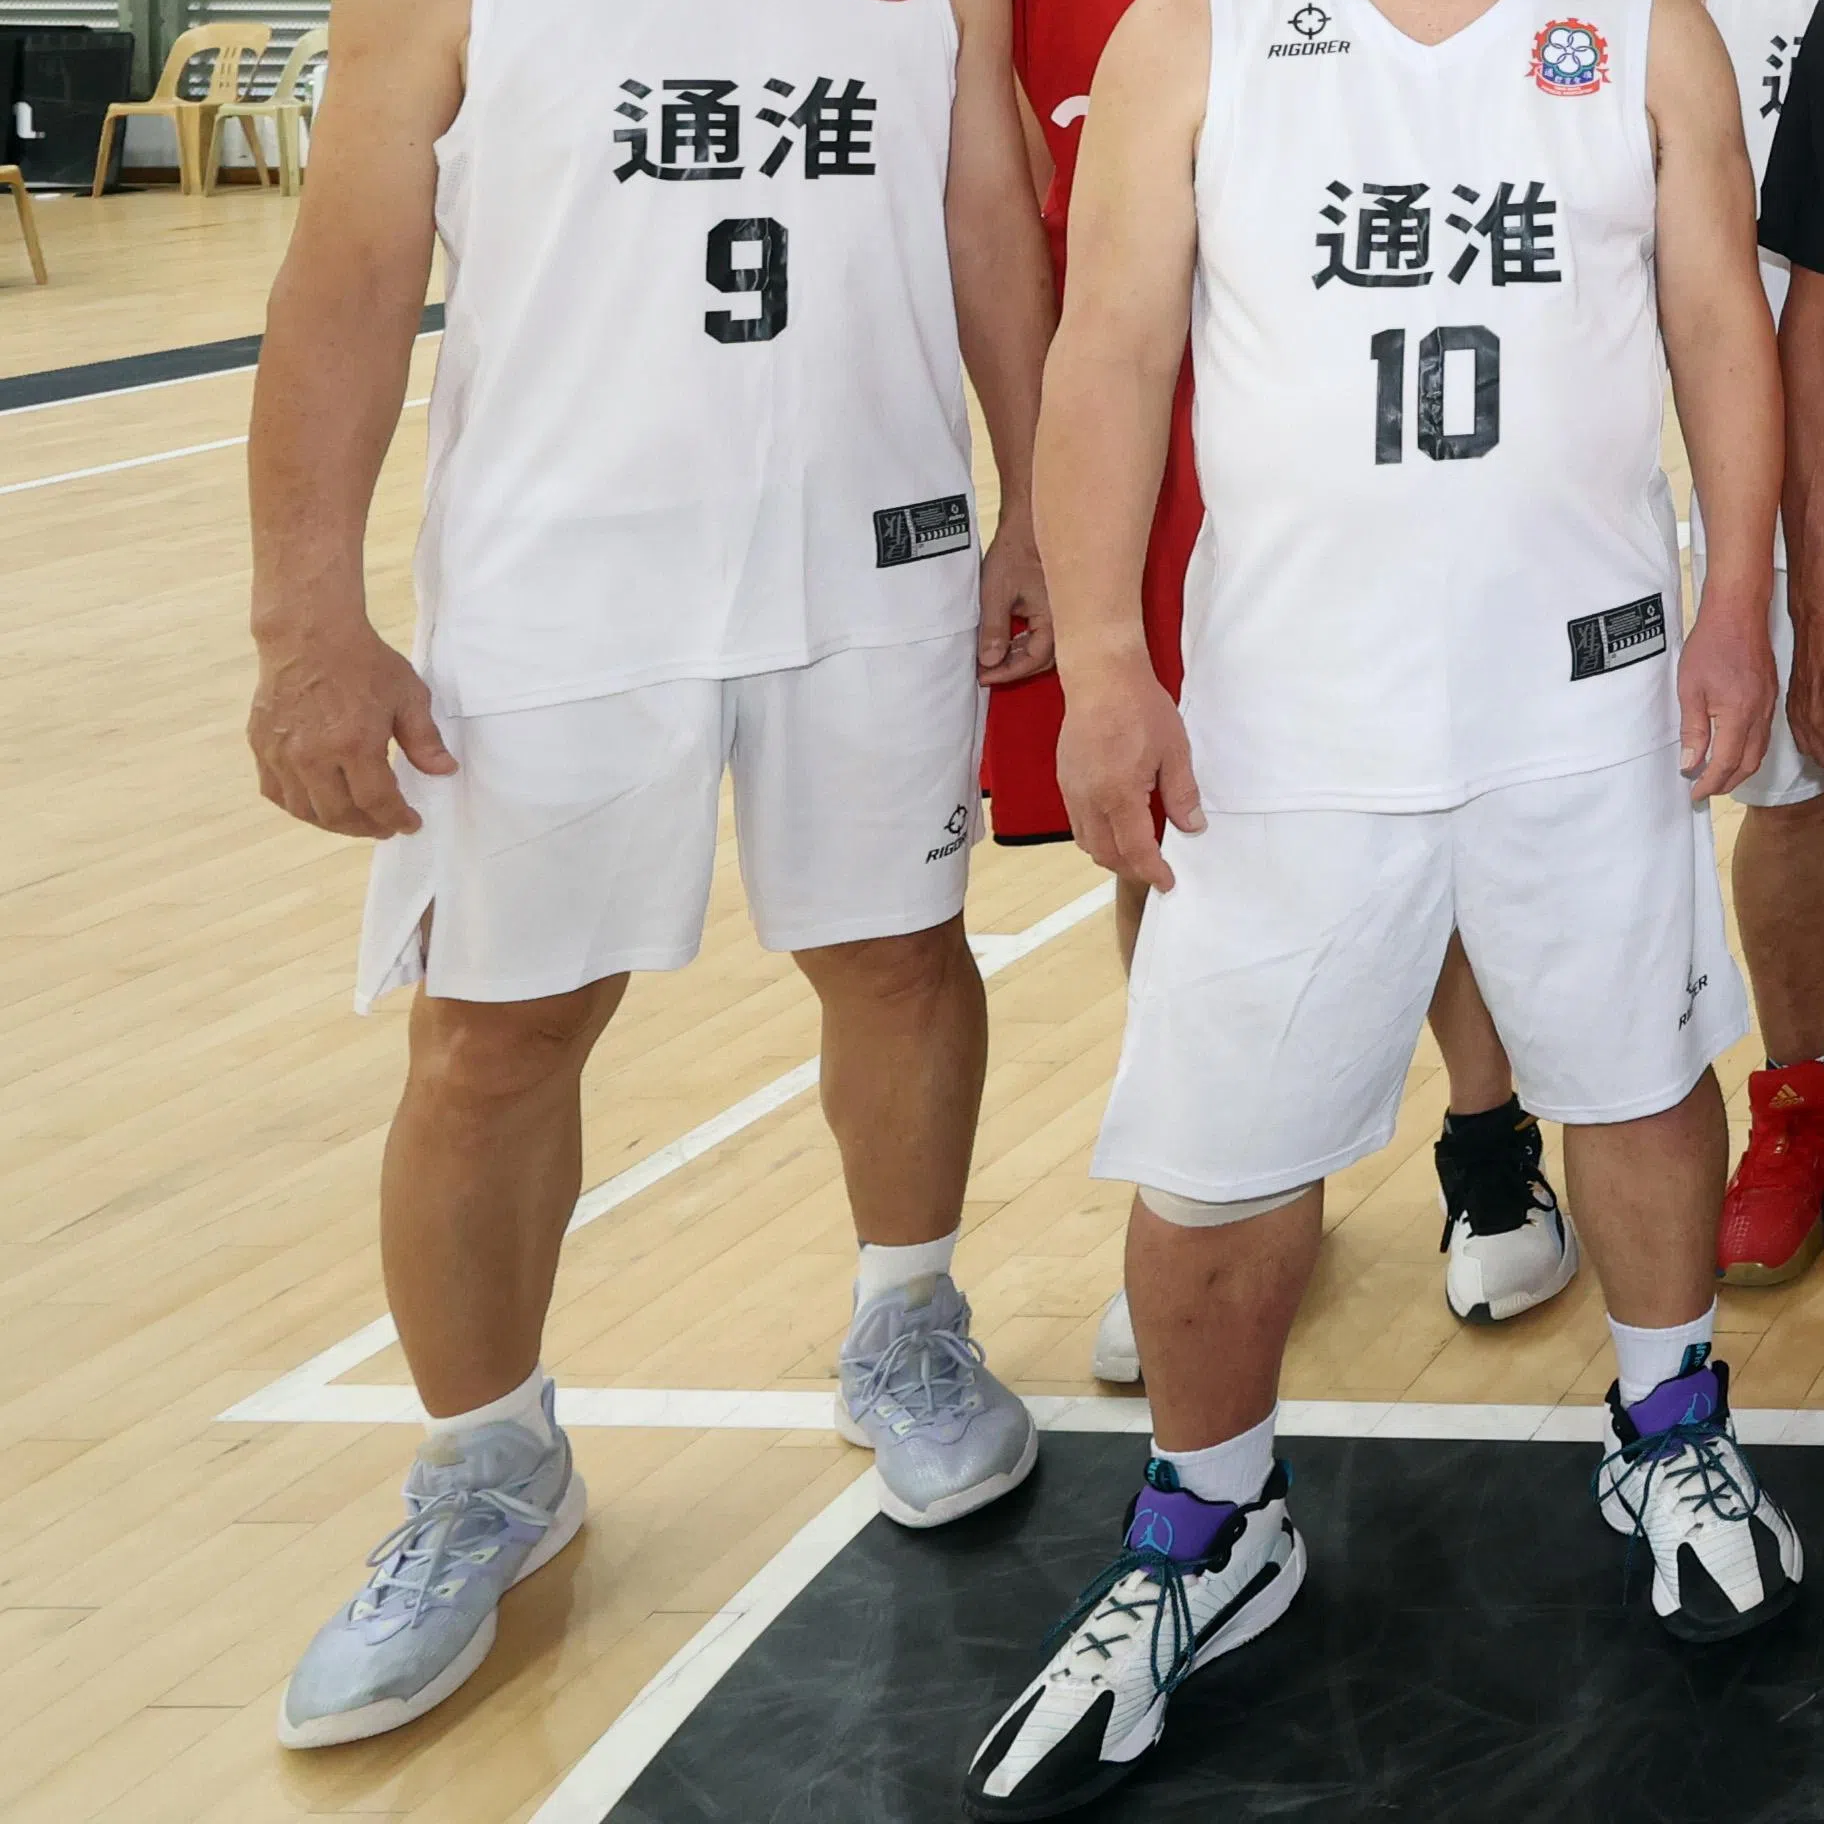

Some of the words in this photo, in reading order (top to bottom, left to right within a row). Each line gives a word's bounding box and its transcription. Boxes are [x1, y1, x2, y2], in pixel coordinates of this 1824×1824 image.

[1267, 39, 1351, 59] RIGORER
[612, 76, 878, 185] 通淮
[704, 217, 789, 340] 9
[1311, 180, 1562, 290] 通淮
[1370, 324, 1501, 465] 10
